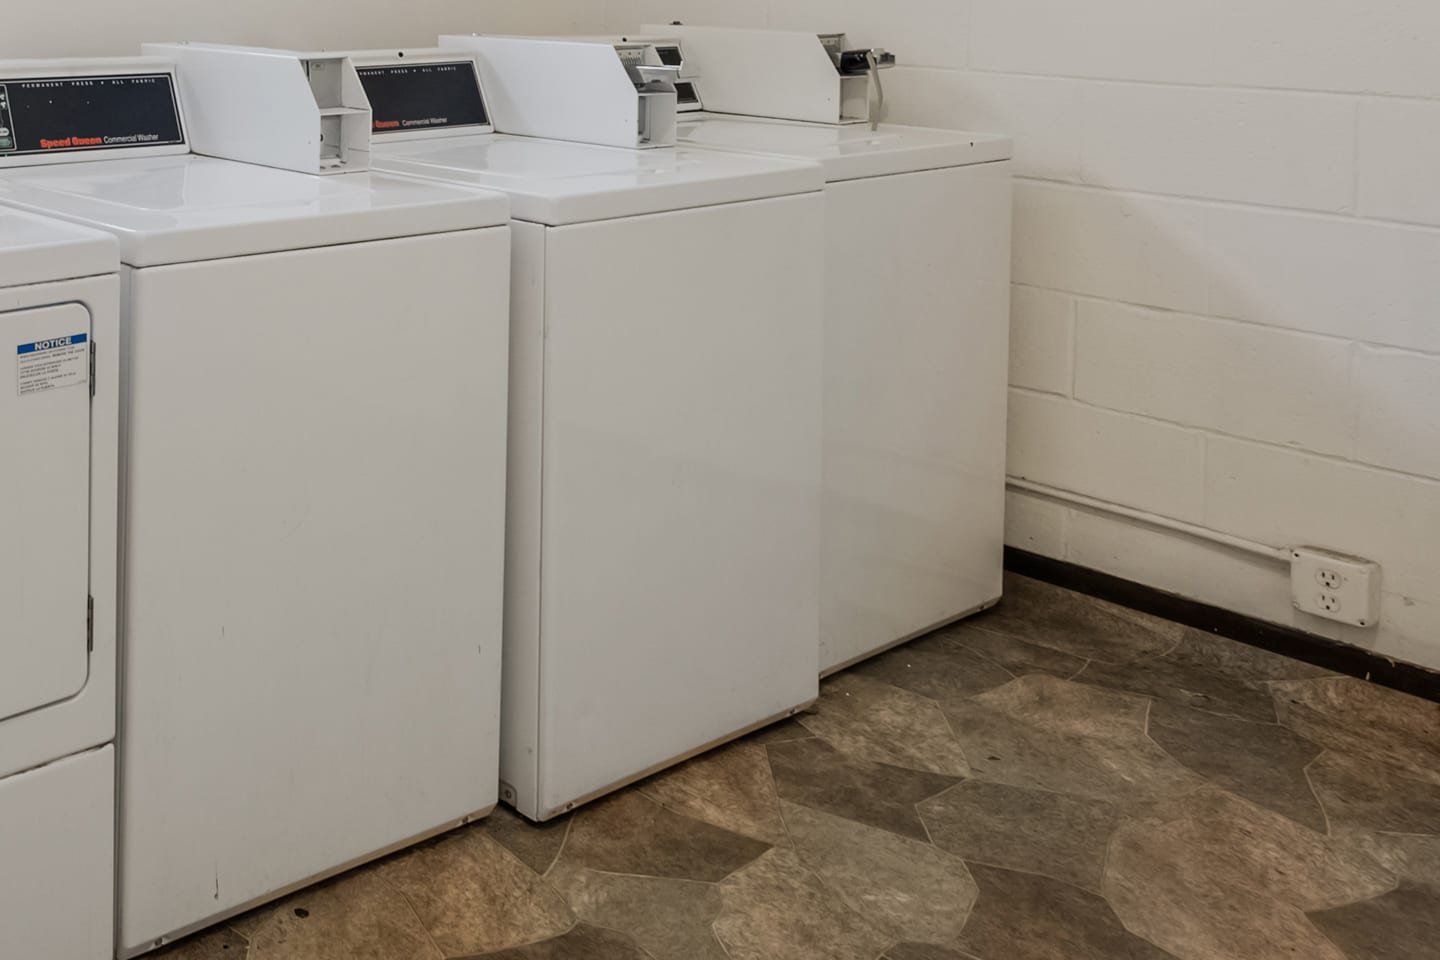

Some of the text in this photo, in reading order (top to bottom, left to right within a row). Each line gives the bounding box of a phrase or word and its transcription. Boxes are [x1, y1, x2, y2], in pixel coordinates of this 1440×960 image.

[40, 137, 71, 149] Speed
[72, 136, 102, 146] Queen
[103, 134, 137, 144] Commercial
[34, 336, 72, 351] NOTICE
